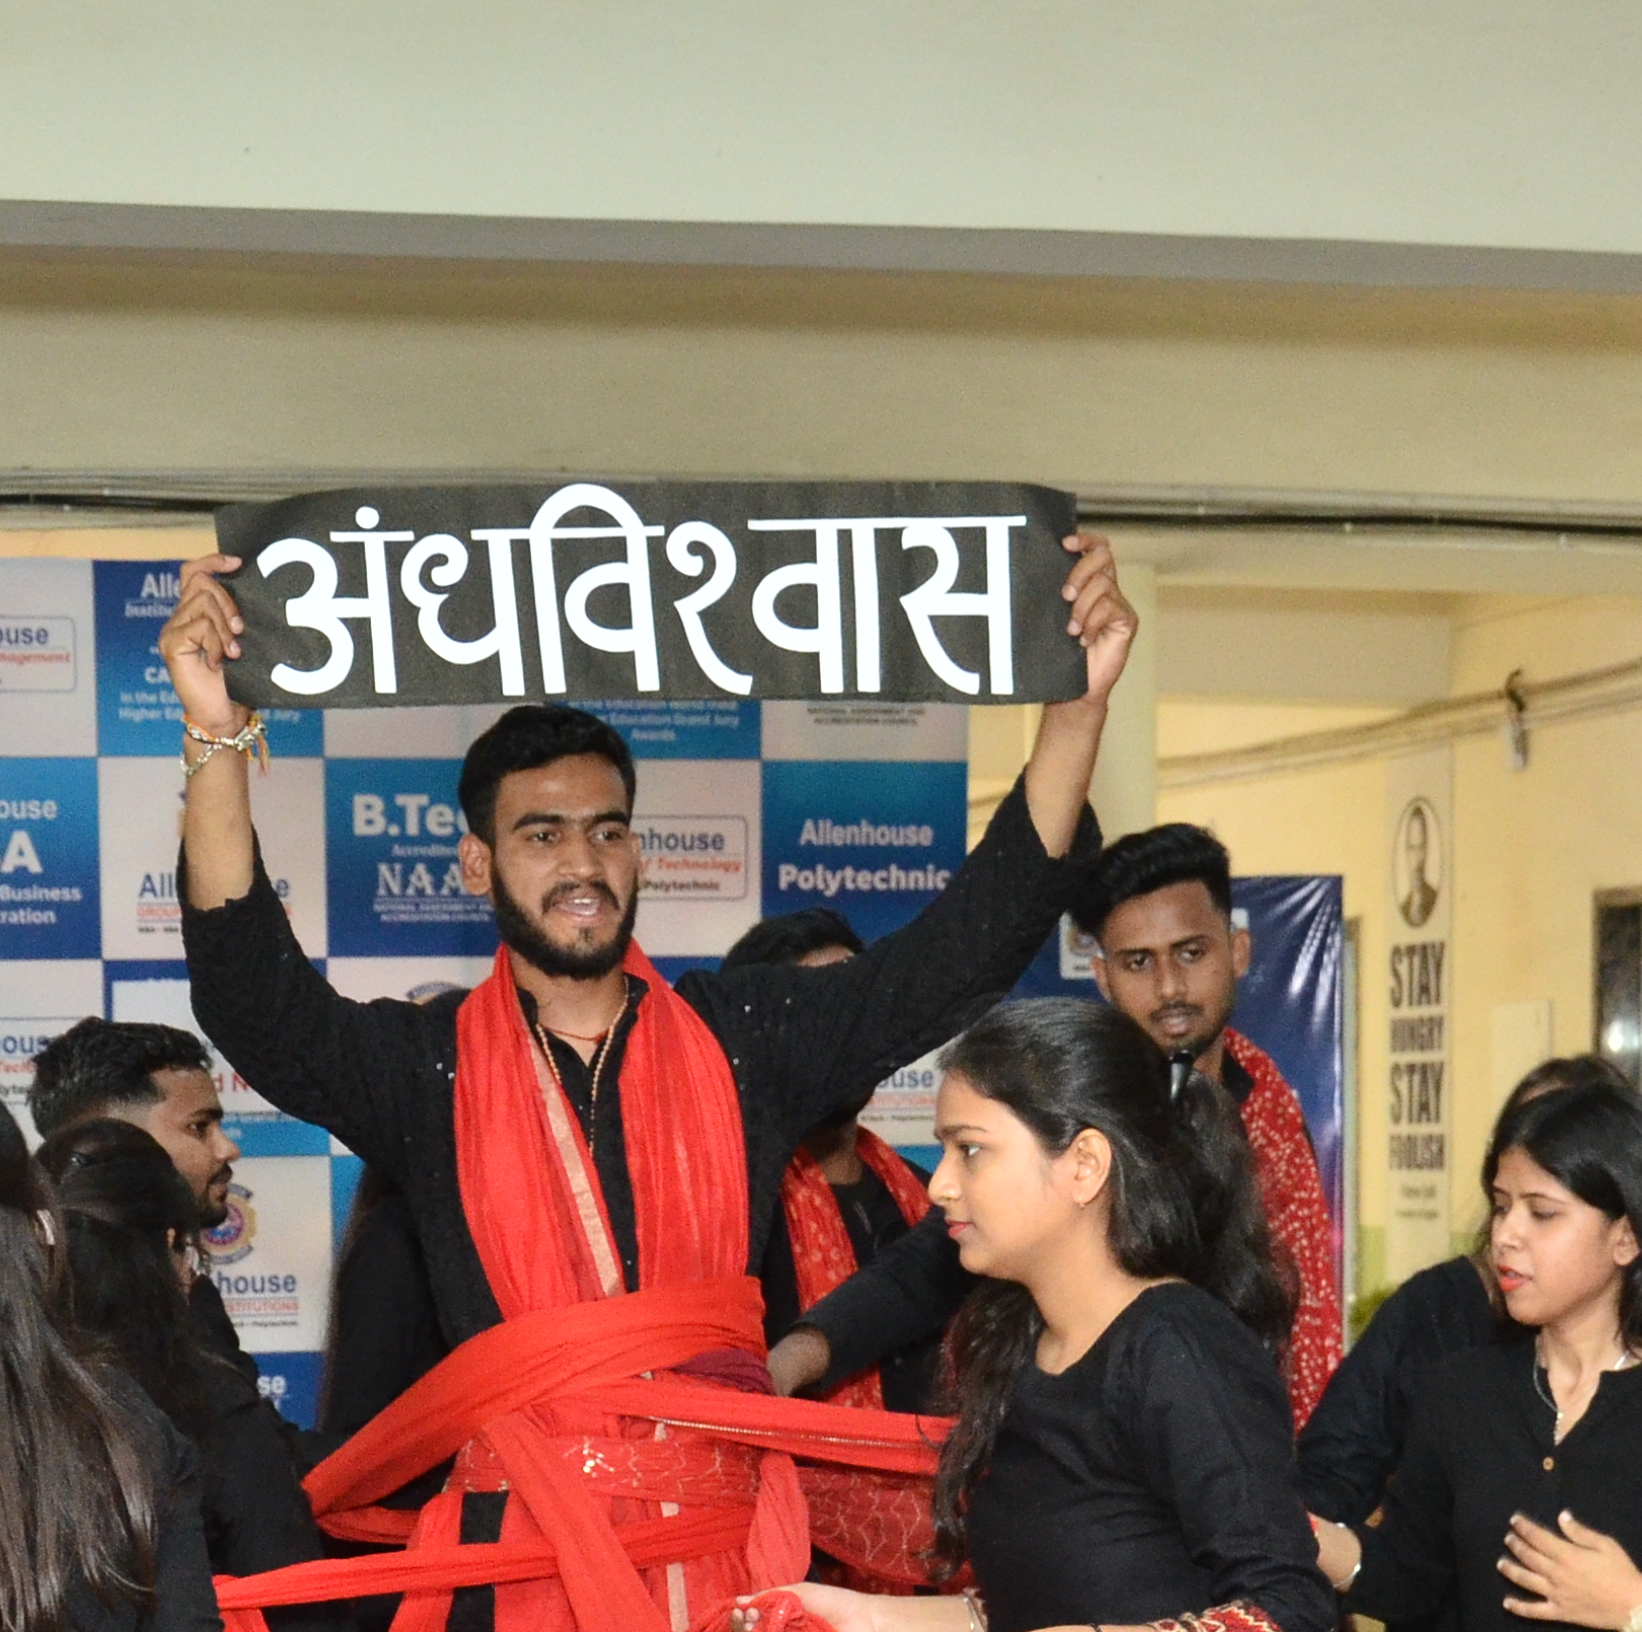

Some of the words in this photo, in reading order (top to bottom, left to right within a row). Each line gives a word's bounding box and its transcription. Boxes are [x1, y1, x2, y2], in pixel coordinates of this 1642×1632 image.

[256, 482, 1028, 697] अंधविश्वास
[353, 793, 470, 836] B.Te
[638, 828, 726, 850] nhouse
[800, 819, 934, 847] Allenhouse
[0, 885, 82, 902] Business
[377, 862, 467, 896] NAA
[778, 863, 952, 898] Polytechnic
[1390, 941, 1445, 1008] STAY
[1390, 1061, 1444, 1126] STAY
